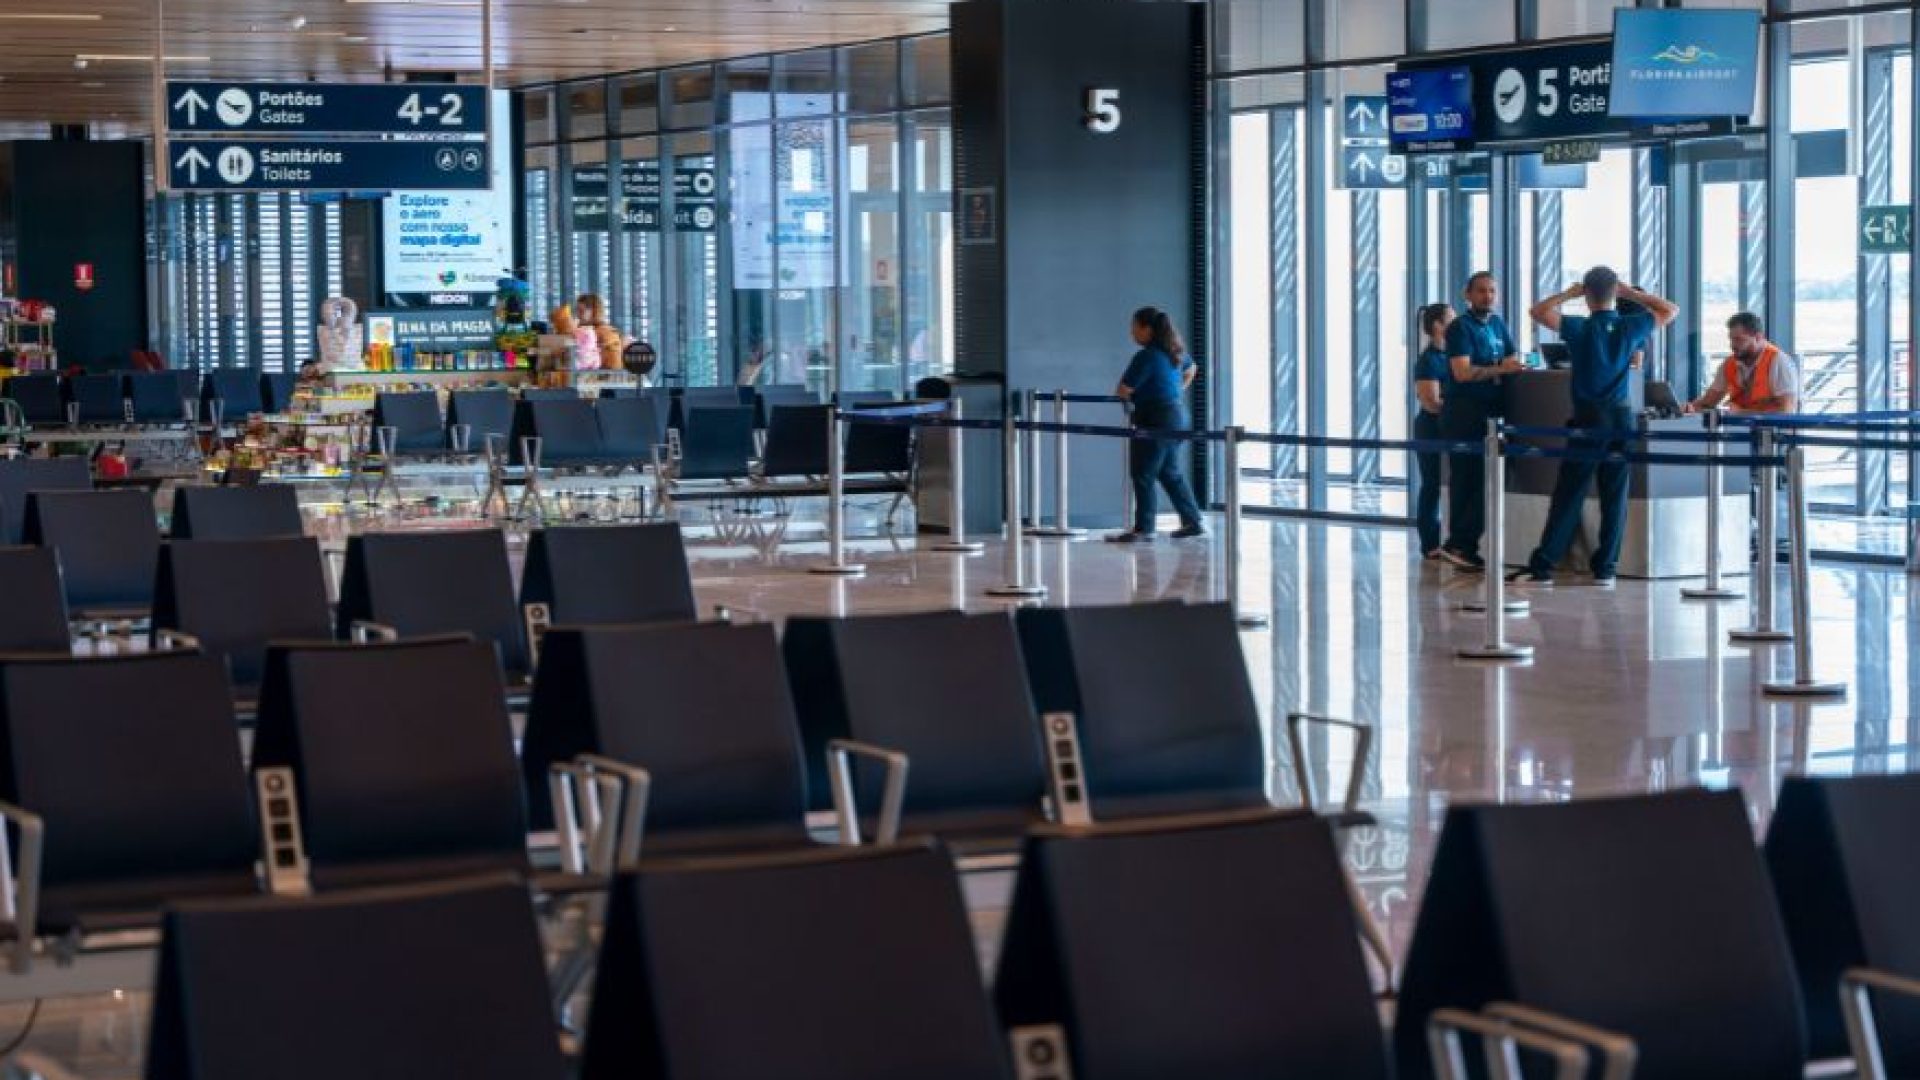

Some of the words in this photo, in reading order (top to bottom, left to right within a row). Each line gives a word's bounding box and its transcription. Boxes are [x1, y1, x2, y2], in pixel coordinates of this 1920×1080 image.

[1569, 63, 1611, 86] Port
[259, 91, 324, 106] Portões
[1537, 67, 1559, 117] 5
[397, 93, 463, 126] 4-2
[1087, 88, 1121, 132] 5
[1569, 94, 1606, 114] Gate
[259, 108, 305, 124] Gates
[260, 147, 342, 164] Sanitários
[261, 166, 312, 180] Toilets
[399, 194, 449, 207] Explore
[412, 209, 441, 219] aero
[619, 209, 653, 224] aída
[400, 223, 429, 233] com
[431, 223, 469, 233] nosso
[400, 235, 438, 247] mapa
[439, 234, 482, 247] digital
[452, 319, 493, 333] MAGIA
